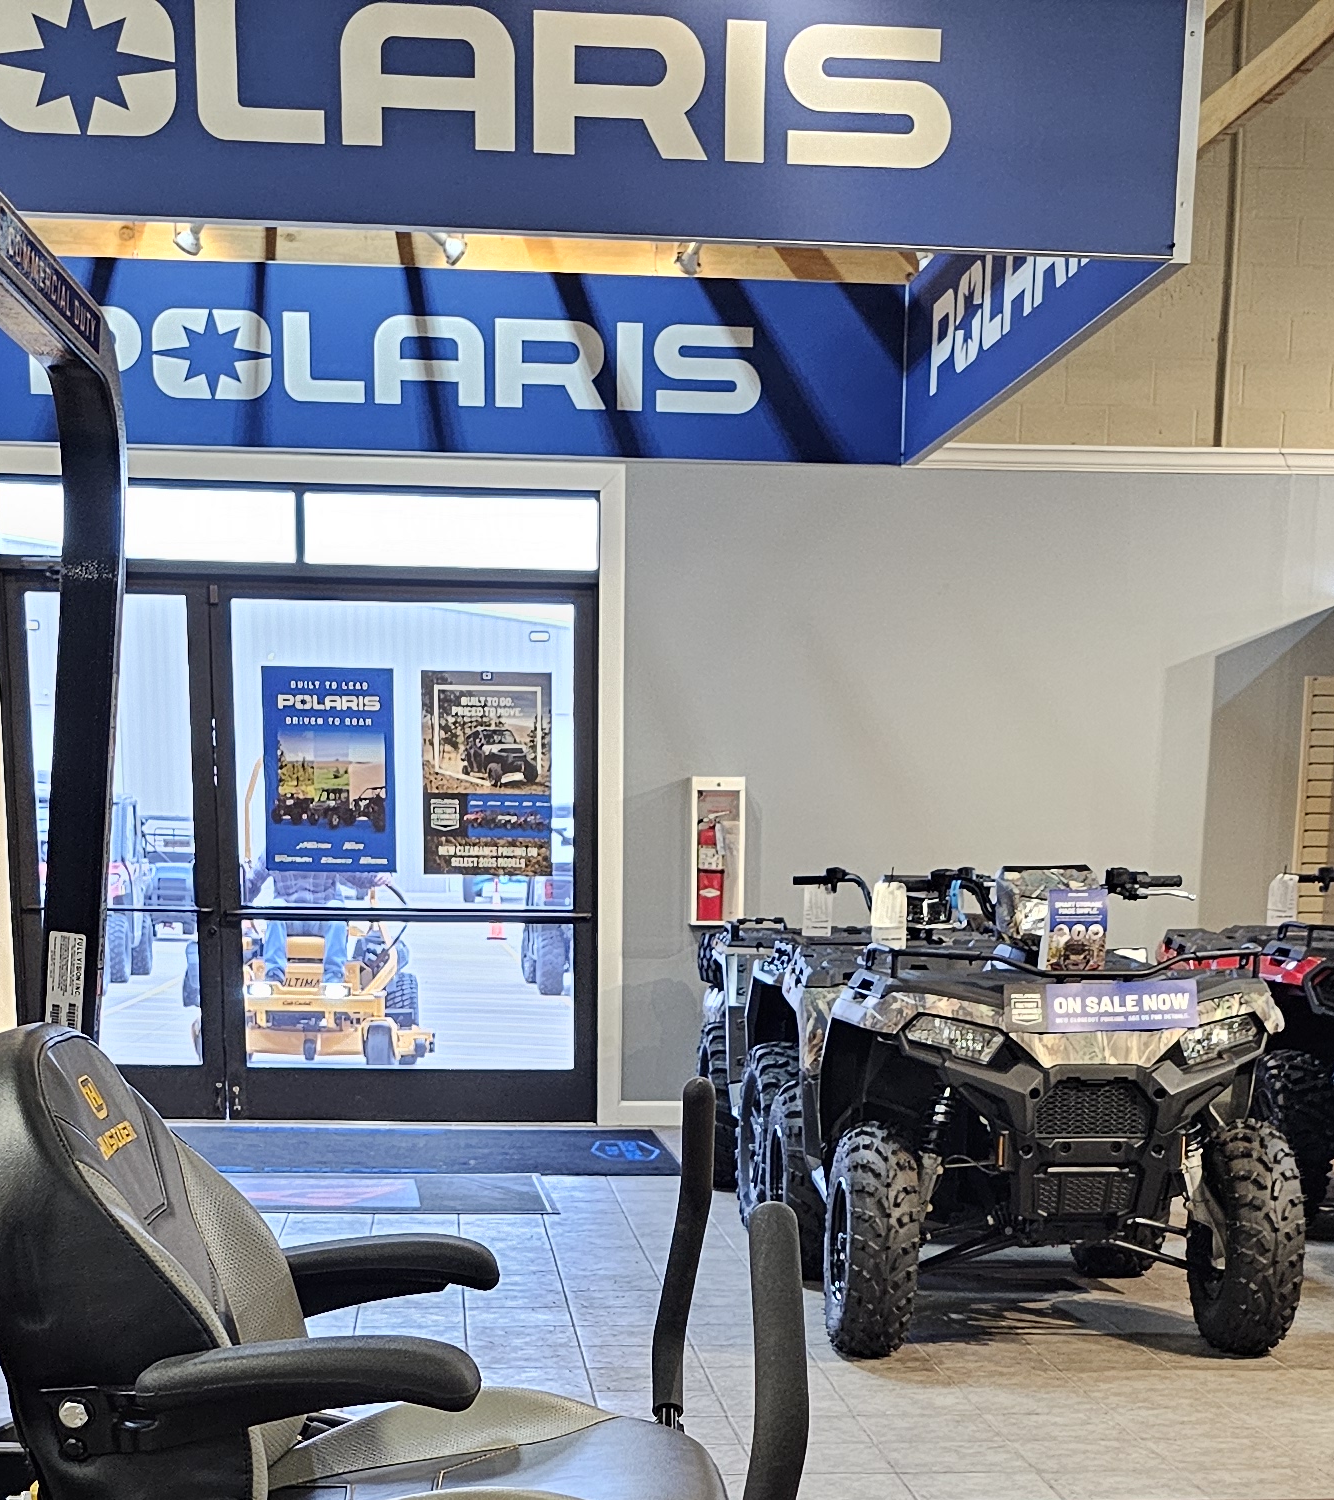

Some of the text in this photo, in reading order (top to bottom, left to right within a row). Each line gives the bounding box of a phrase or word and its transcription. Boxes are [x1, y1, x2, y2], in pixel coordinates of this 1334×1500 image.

[7, 226, 97, 342] COMMERCIAL DUTY
[290, 680, 369, 690] BUILT TO LEAD
[277, 694, 381, 711] POLARIS
[460, 696, 486, 706] BUILT
[486, 697, 499, 706] TO
[451, 706, 524, 717] PRICED TO MOVE.
[285, 717, 372, 726] DRIVEN TO ROAM
[76, 937, 84, 956] FULL
[75, 957, 83, 983] VISION
[1053, 993, 1190, 1014] ON SALE NOW
